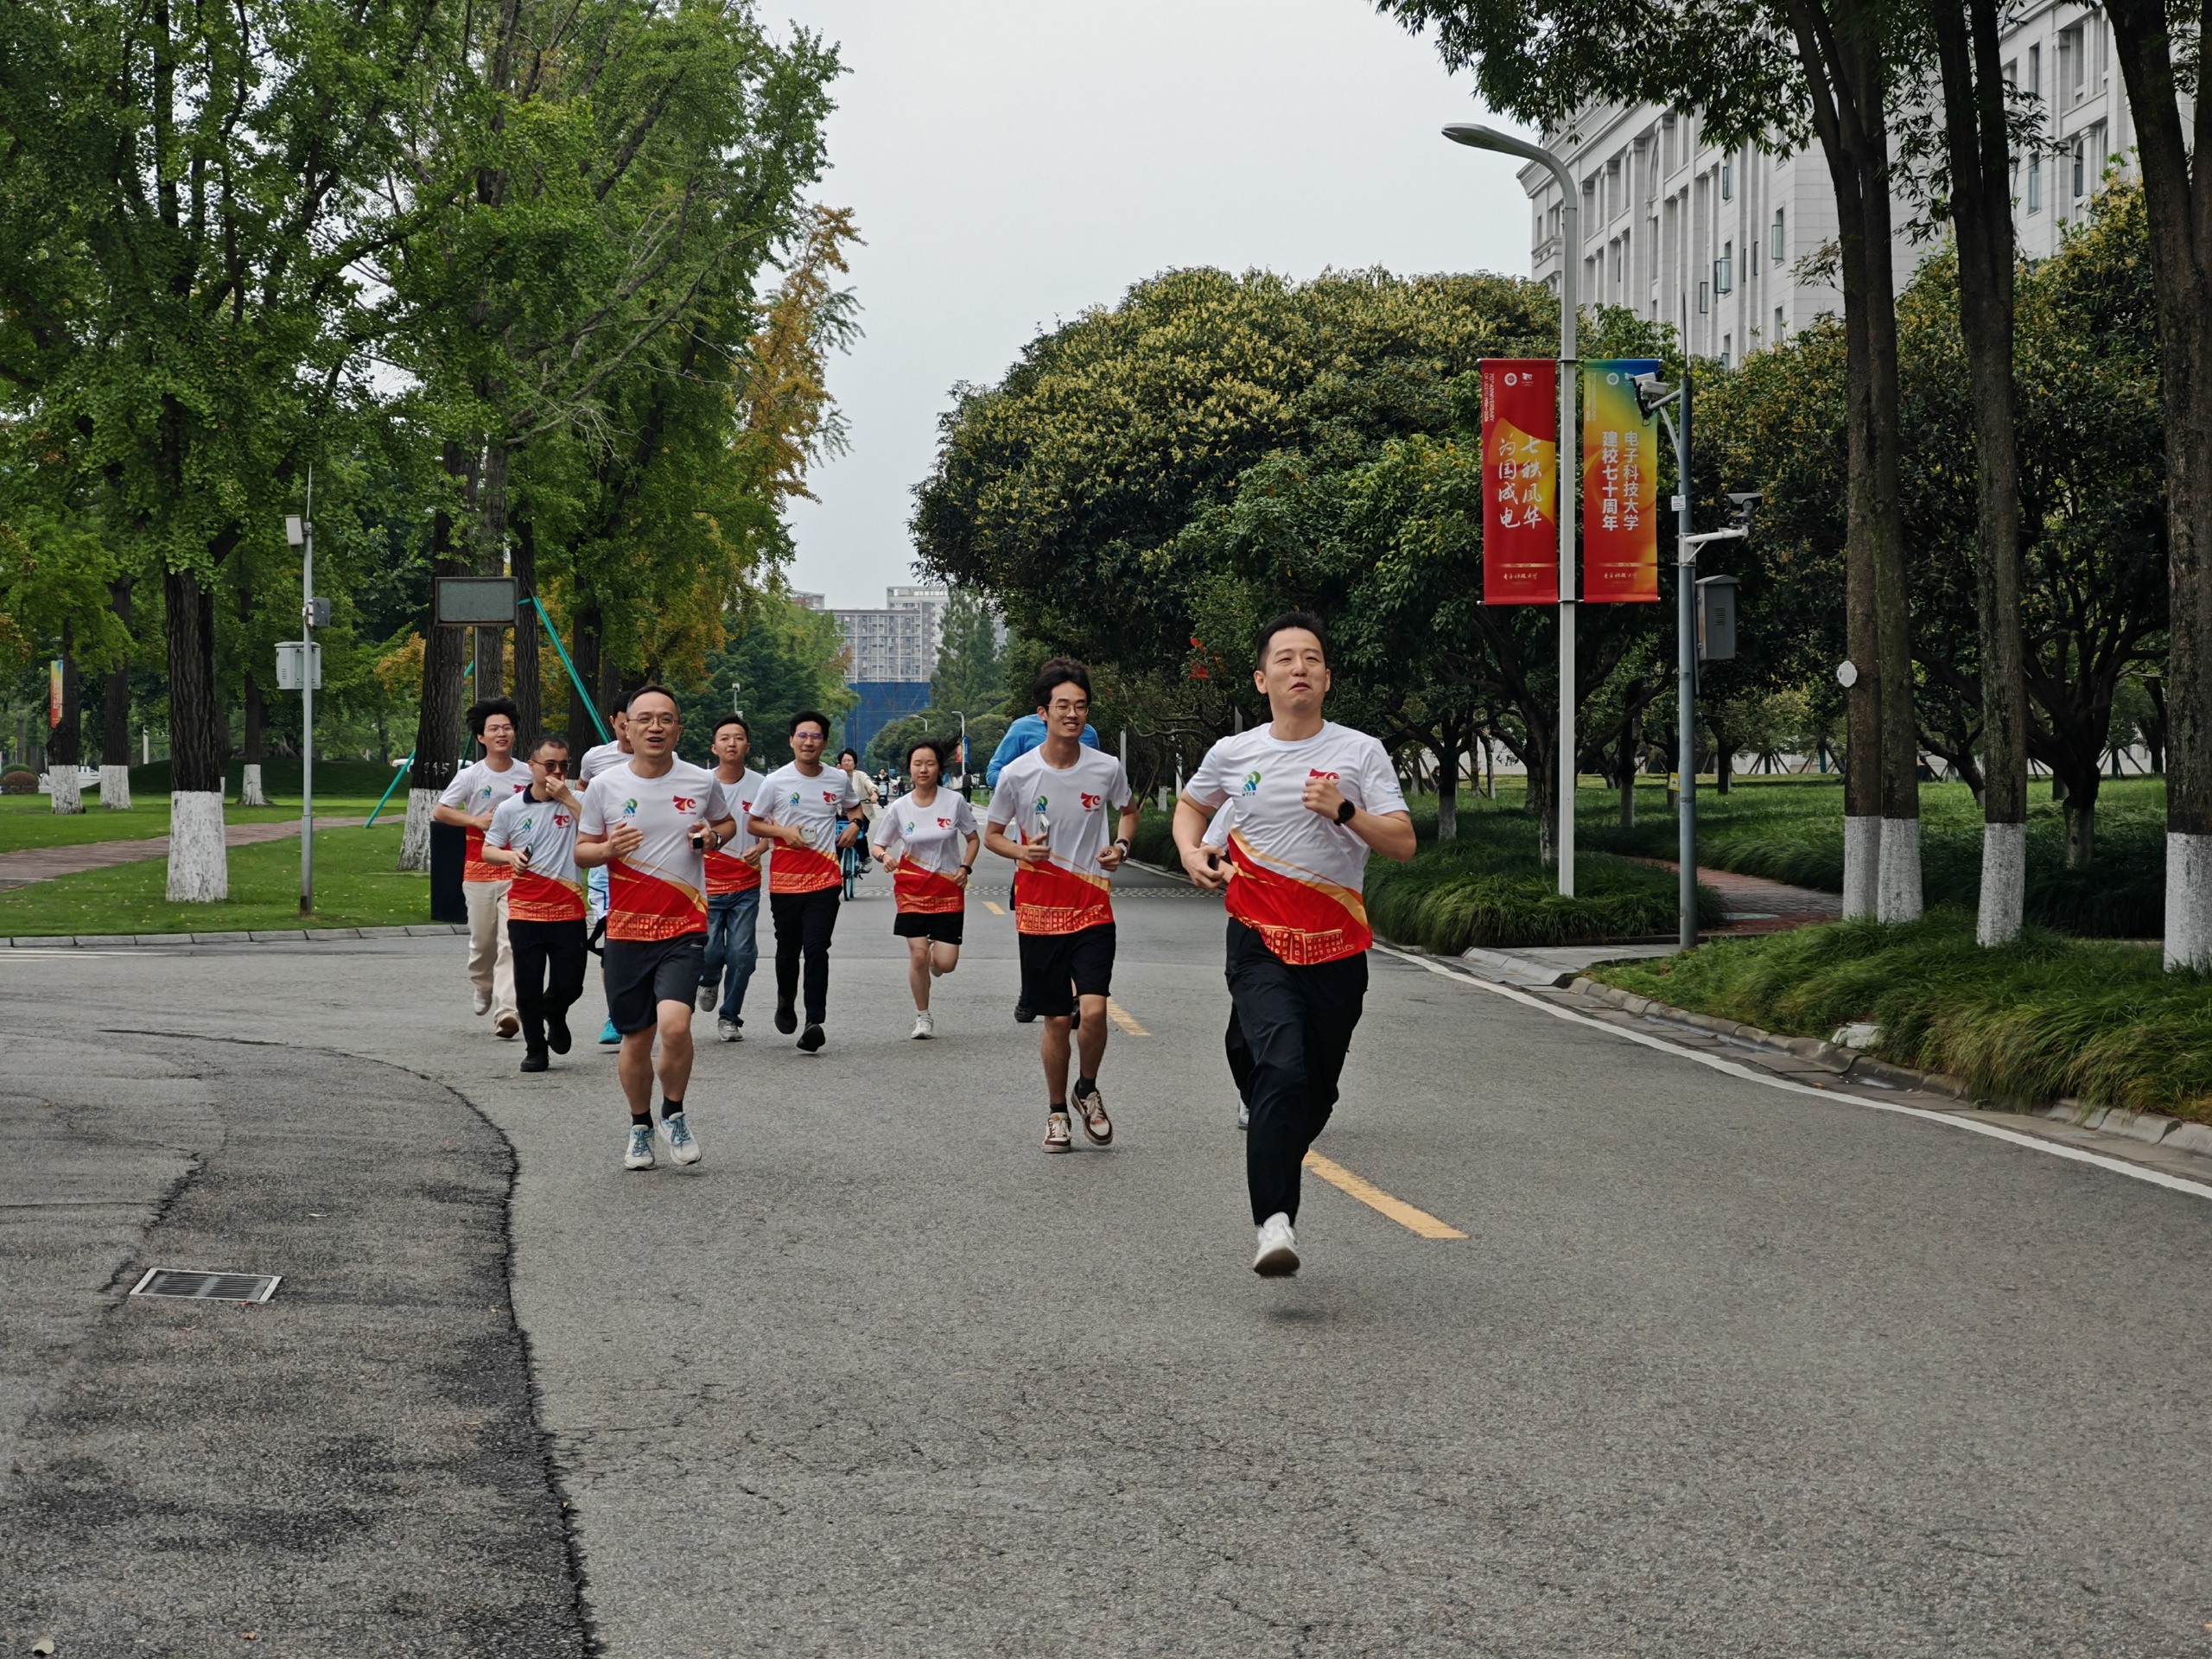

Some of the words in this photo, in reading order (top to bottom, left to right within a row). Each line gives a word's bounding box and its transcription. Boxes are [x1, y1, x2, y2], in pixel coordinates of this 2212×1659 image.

[1521, 435, 1542, 530] 七秩风华
[1602, 430, 1618, 531] 建校七十周年
[1624, 430, 1638, 531] 电子科技大学
